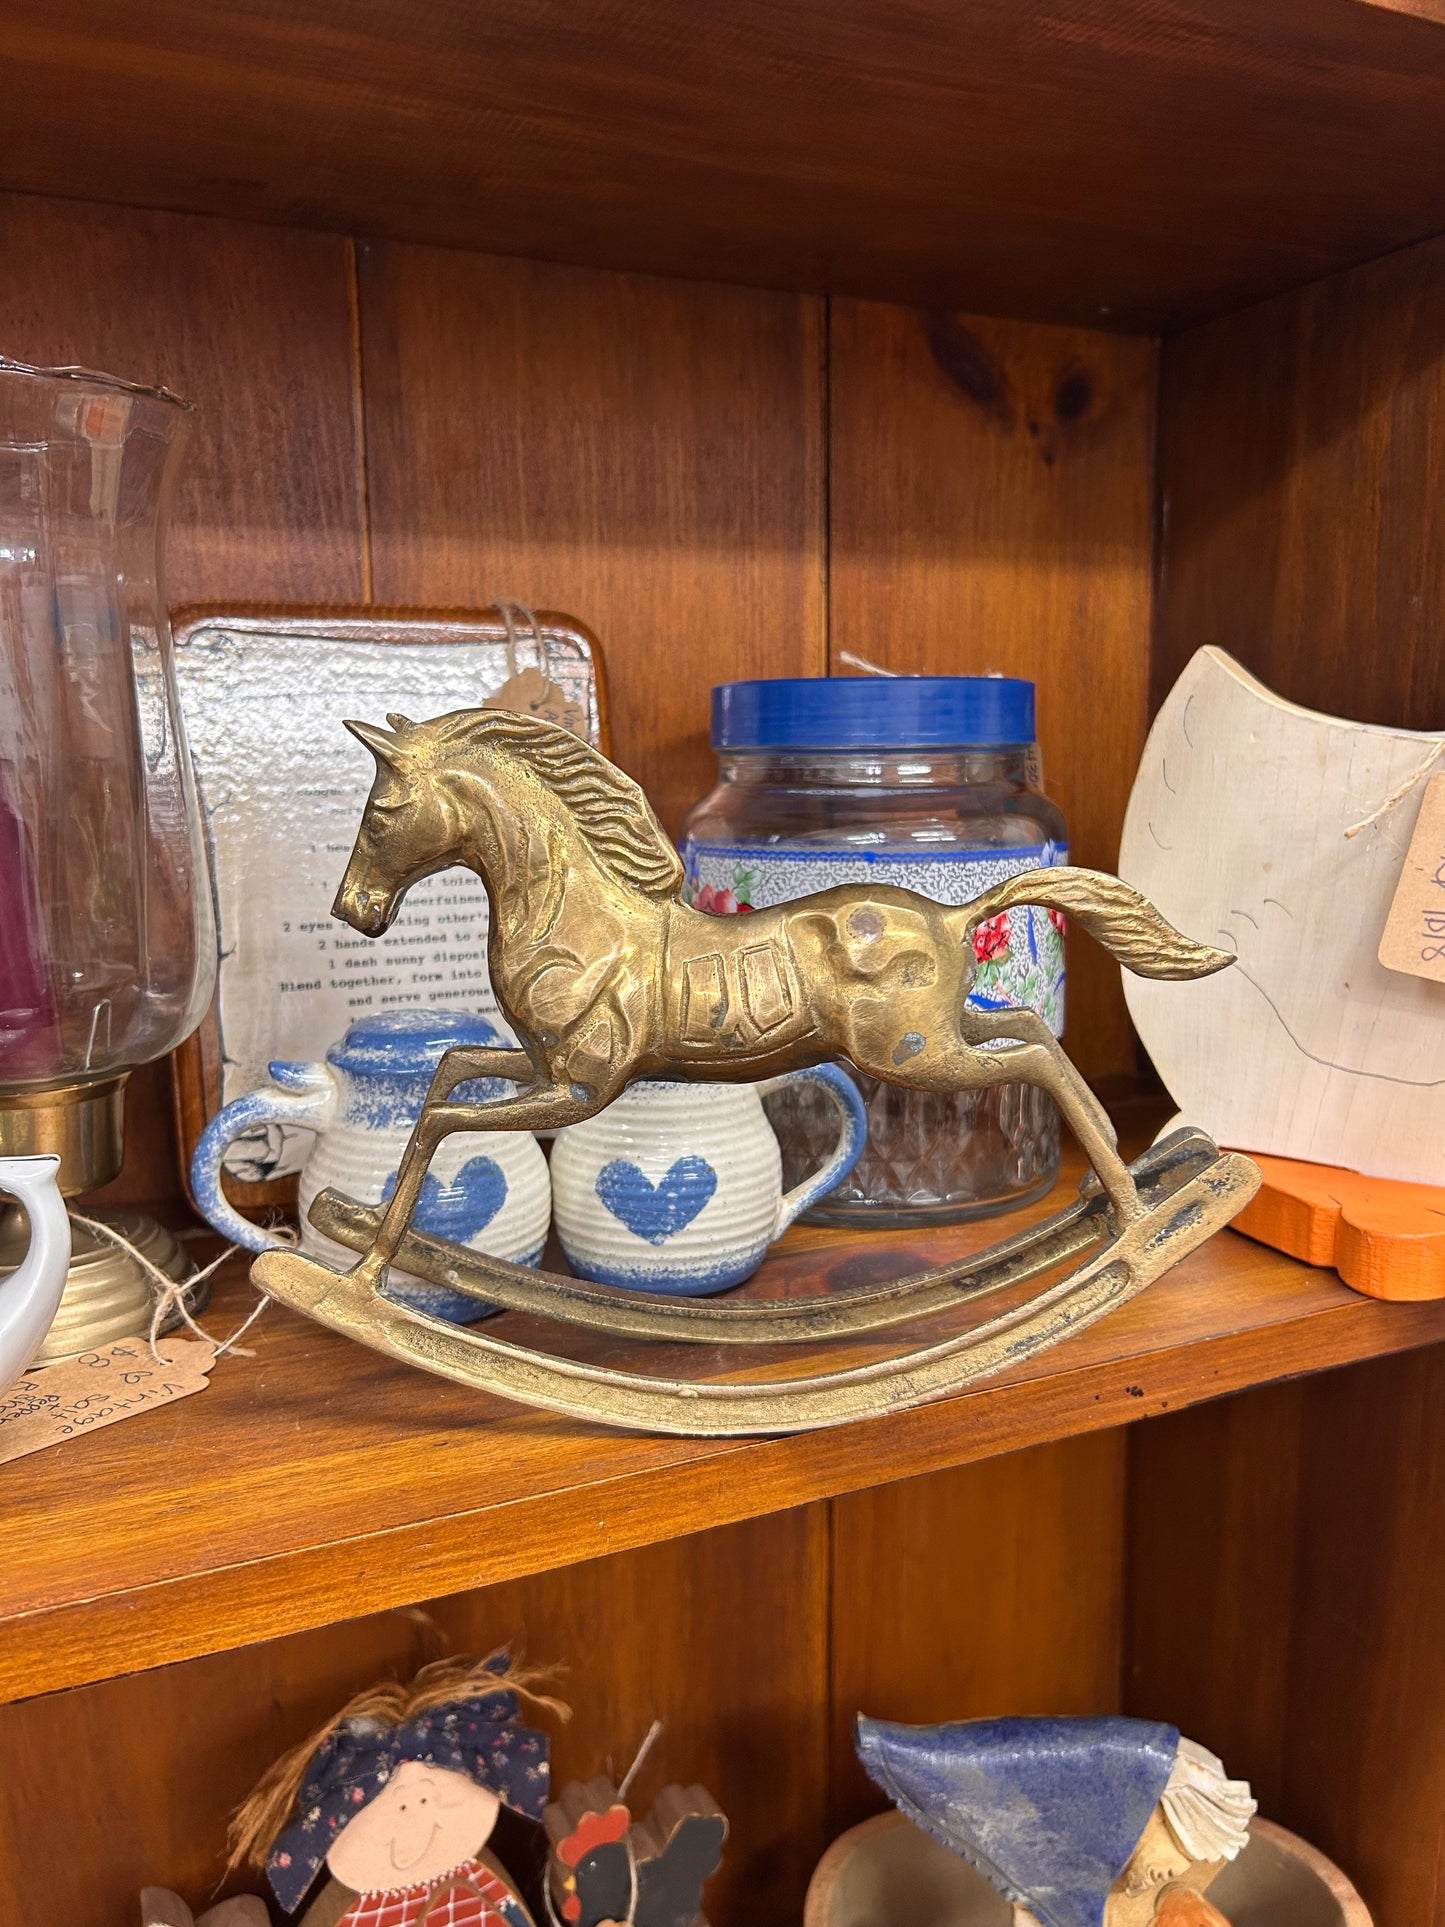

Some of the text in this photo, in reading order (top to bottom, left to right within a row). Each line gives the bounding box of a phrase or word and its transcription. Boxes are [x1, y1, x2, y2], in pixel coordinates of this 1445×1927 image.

[443, 877, 479, 887] toler
[283, 923, 292, 933] 2
[300, 922, 333, 934] eyes
[319, 940, 327, 951] 2
[335, 938, 376, 950] hands
[384, 933, 447, 947] extended
[456, 932, 471, 942] to
[329, 949, 486, 970] 1 dash sunny disposi
[280, 970, 482, 993] Blend together, form into
[349, 988, 490, 1008] and serve generous
